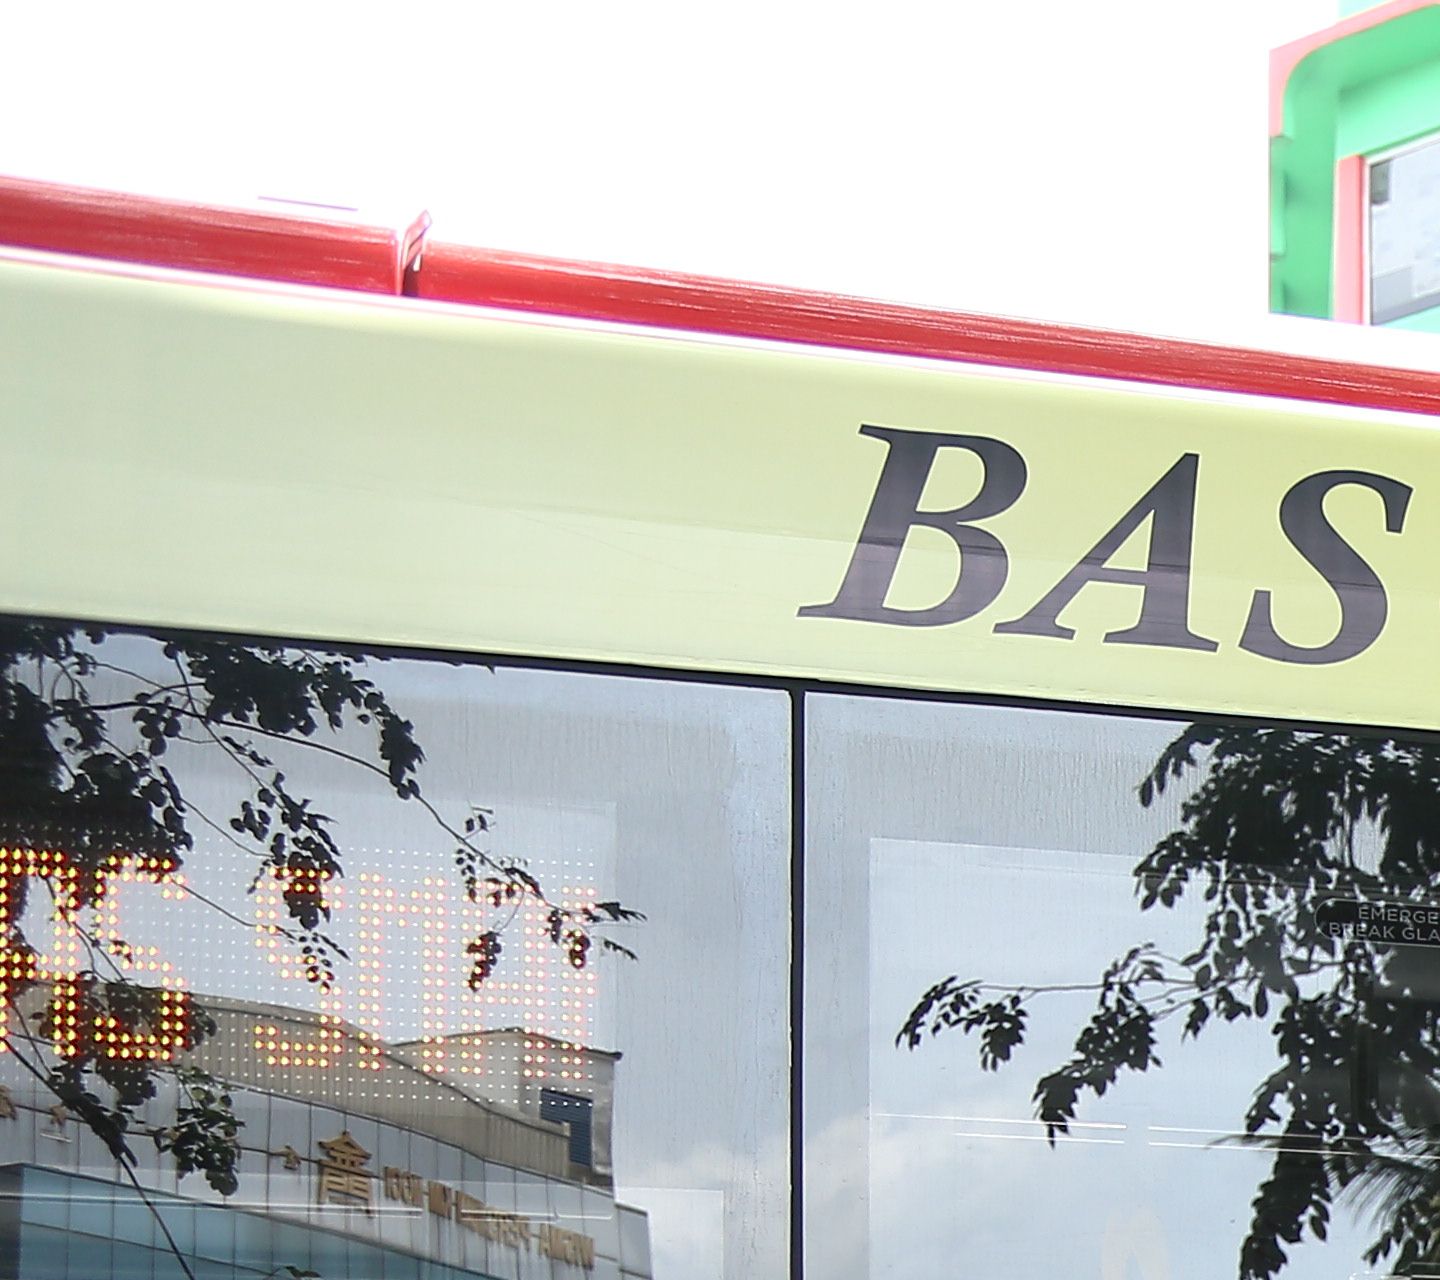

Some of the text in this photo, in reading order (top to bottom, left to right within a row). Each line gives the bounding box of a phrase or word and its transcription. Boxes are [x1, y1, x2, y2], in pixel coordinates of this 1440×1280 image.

[798, 424, 1411, 665] BAS
[254, 866, 598, 1082] SMA
[1328, 921, 1396, 940] BREAK
